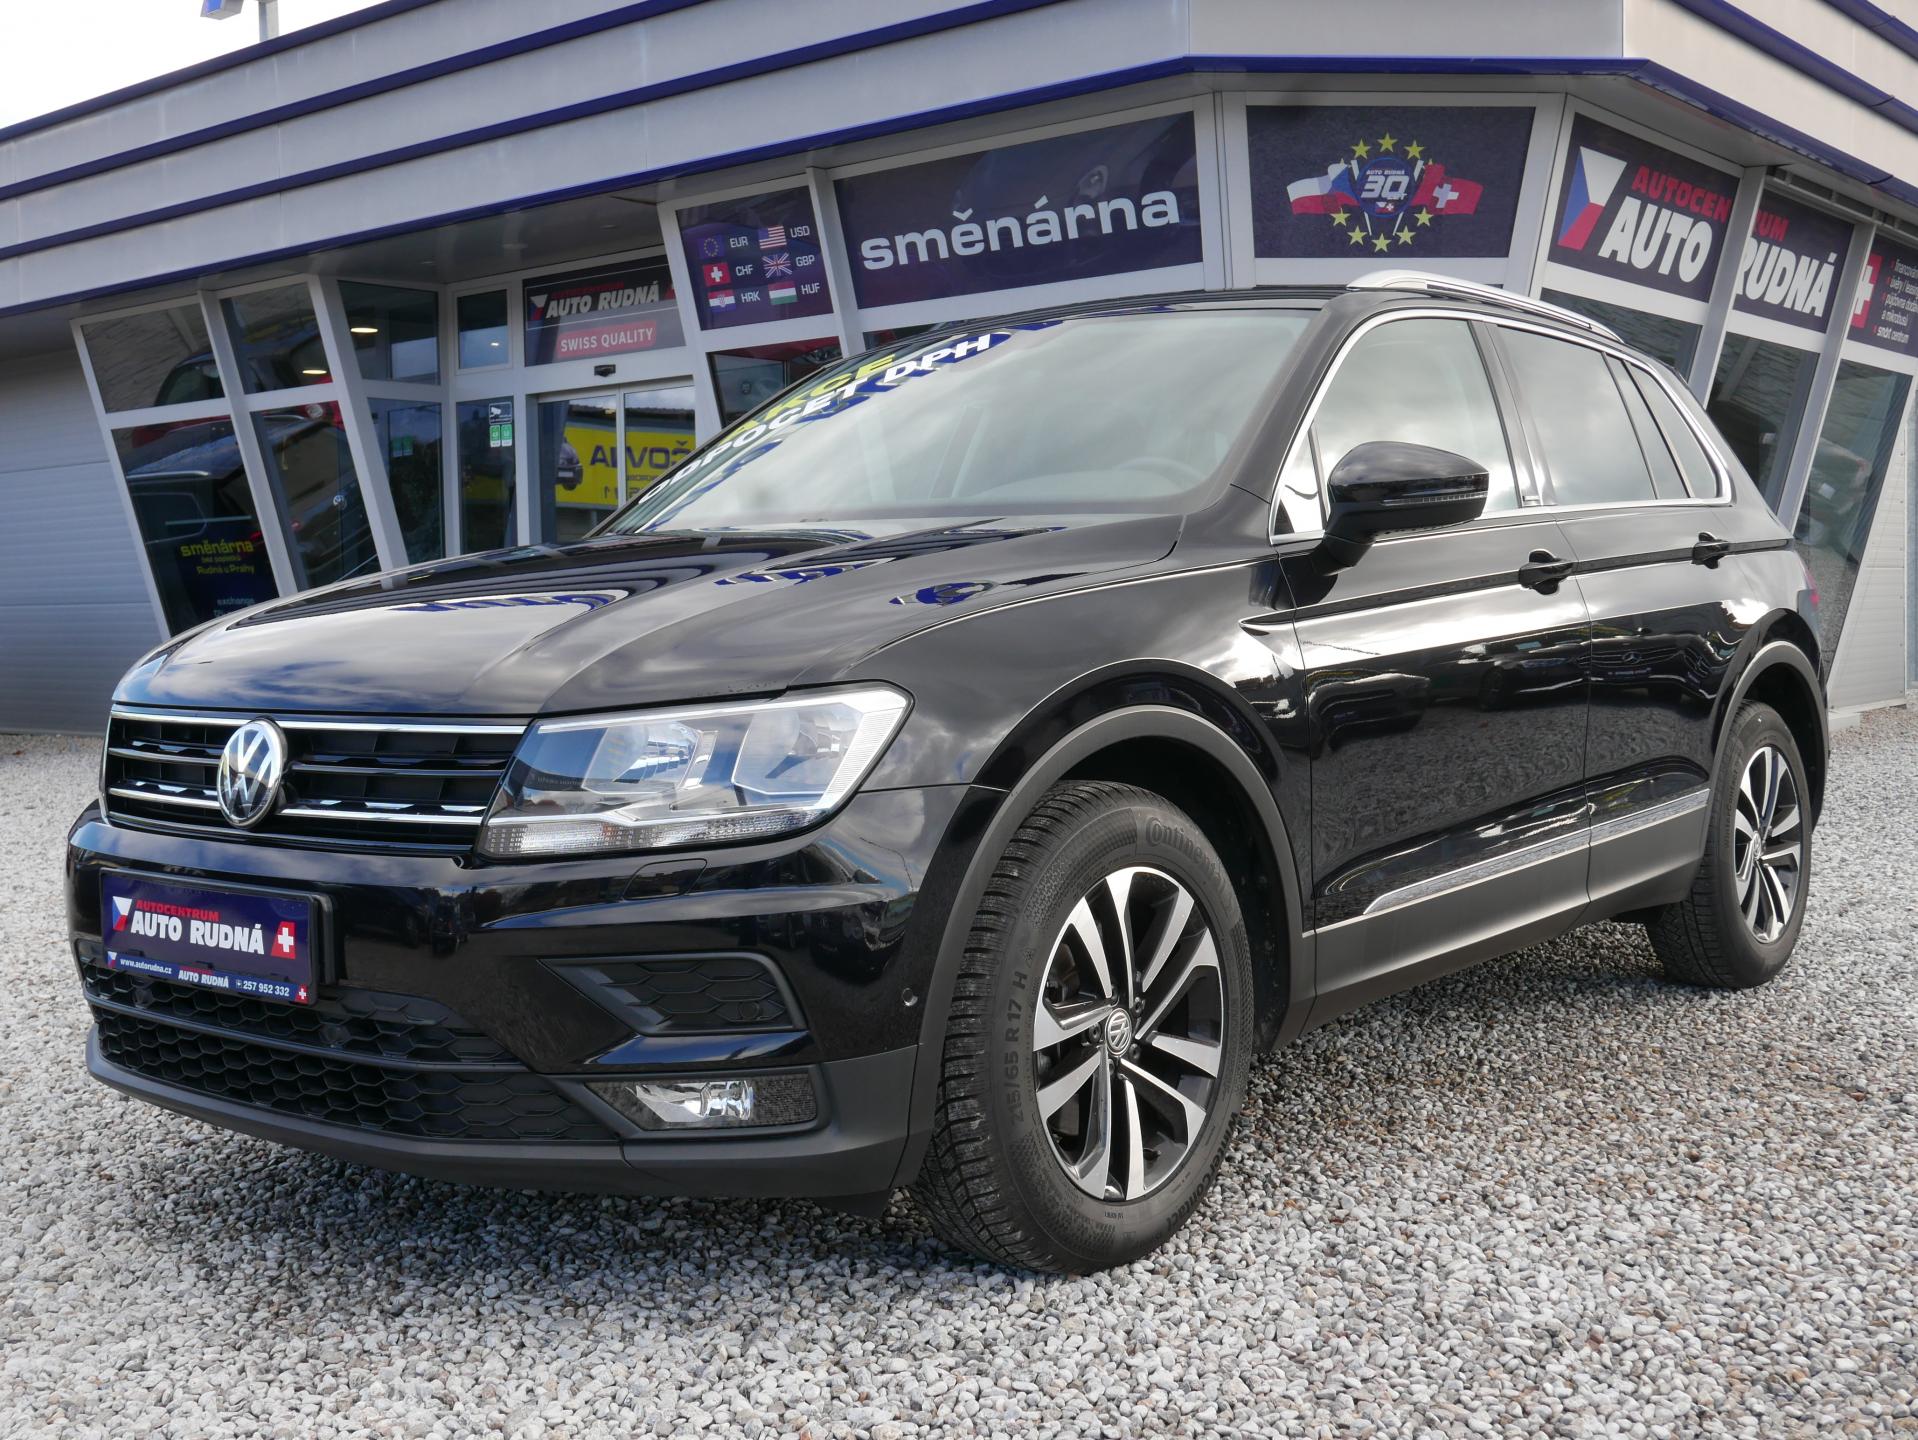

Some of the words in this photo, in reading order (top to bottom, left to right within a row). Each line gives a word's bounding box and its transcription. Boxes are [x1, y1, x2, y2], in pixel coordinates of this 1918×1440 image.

[1360, 175, 1410, 198] 30
[790, 225, 810, 238] USD
[859, 189, 1181, 271] směnárna
[730, 236, 749, 248] EUR
[795, 255, 815, 267] GBP
[1598, 195, 1713, 283] AUTO
[1736, 237, 1838, 318] RUDNÁ
[736, 264, 754, 276] CHF
[546, 295, 592, 319] AUTO
[597, 281, 660, 311] RUDNÁ
[741, 291, 761, 303] HRK
[801, 283, 820, 295] HUF
[560, 335, 597, 352] SWISS
[601, 327, 653, 348] QUALITY
[884, 333, 991, 383] DPH
[180, 539, 255, 557] směnárna
[135, 899, 220, 923] AUTOCENTRUM
[130, 910, 183, 942] AUTO
[189, 919, 265, 955] RUDNÁ
[119, 957, 172, 976] www.autorudna.cz
[177, 968, 199, 984] AUTO
[200, 973, 229, 989] RUDNÁ
[242, 979, 257, 991] 257
[258, 981, 273, 994] 952
[274, 984, 290, 997] 332
